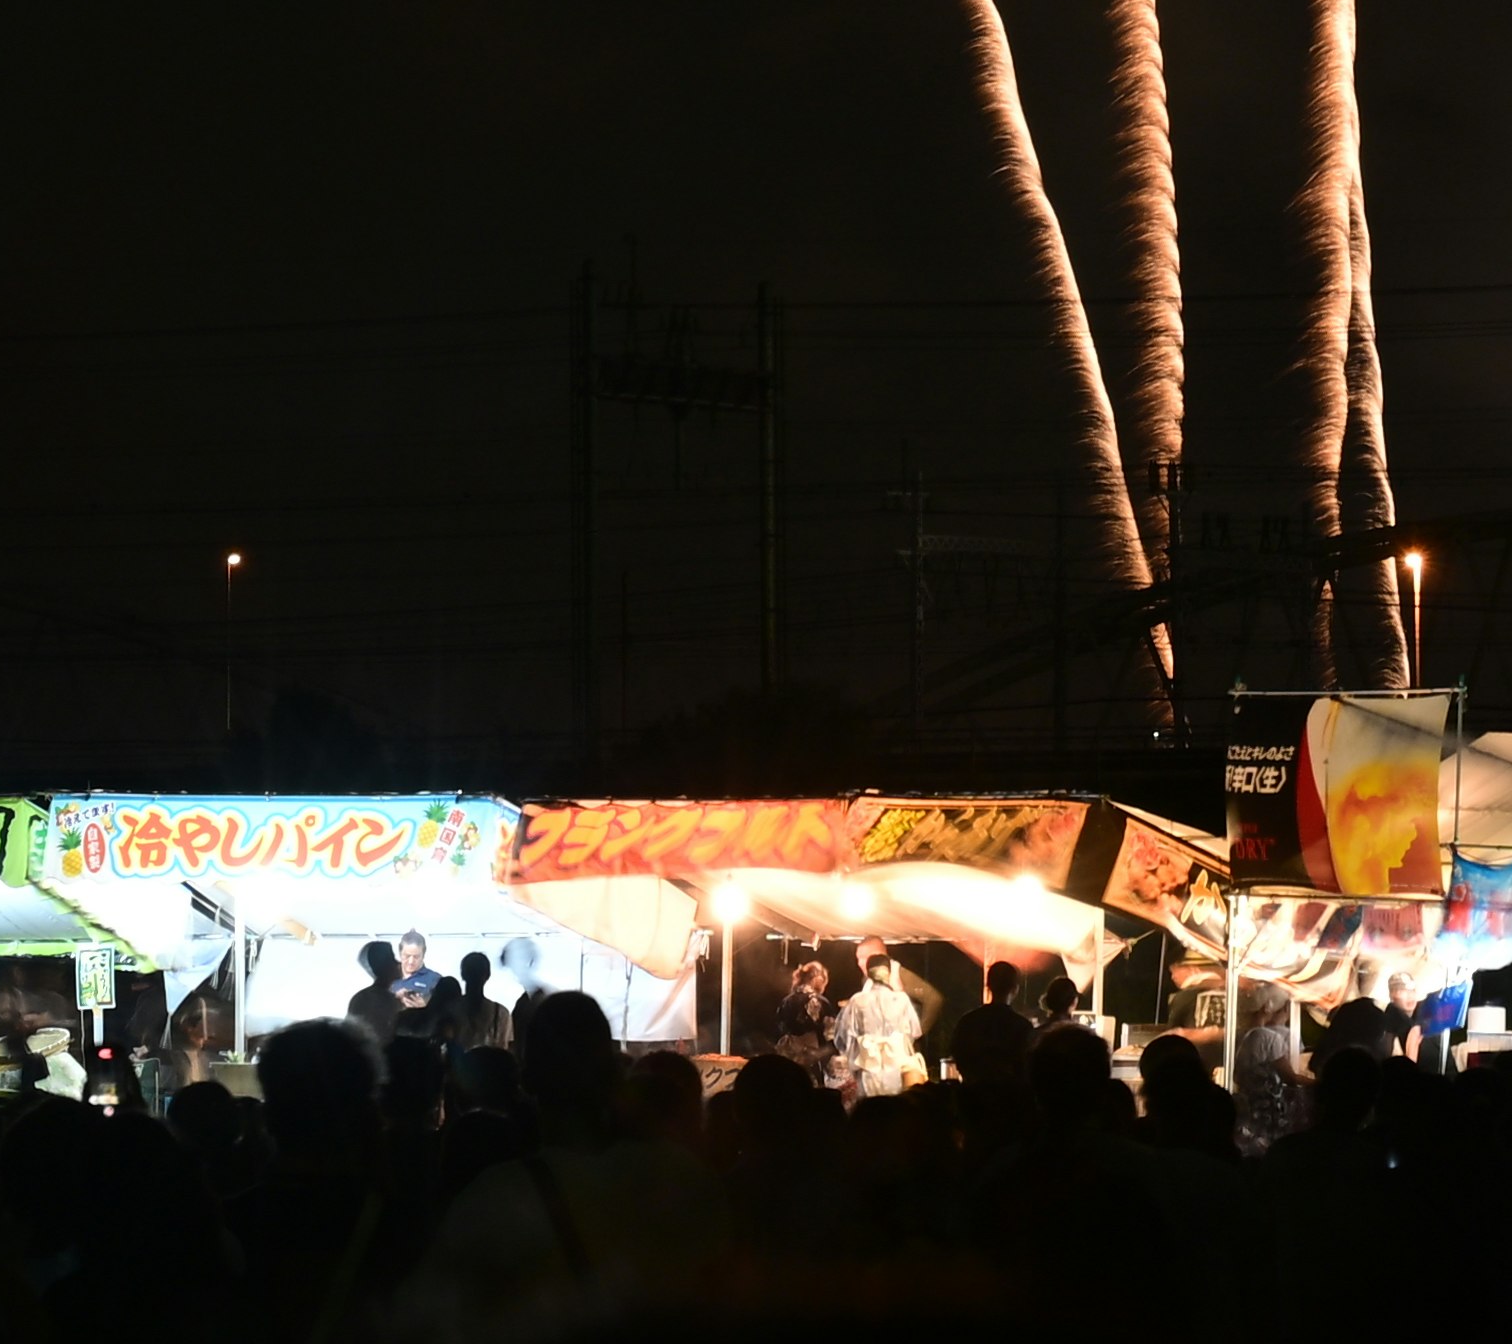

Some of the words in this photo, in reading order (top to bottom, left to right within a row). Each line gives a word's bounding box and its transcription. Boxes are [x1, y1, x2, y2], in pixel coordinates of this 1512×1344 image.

[118, 812, 404, 869] 冷やしパイン
